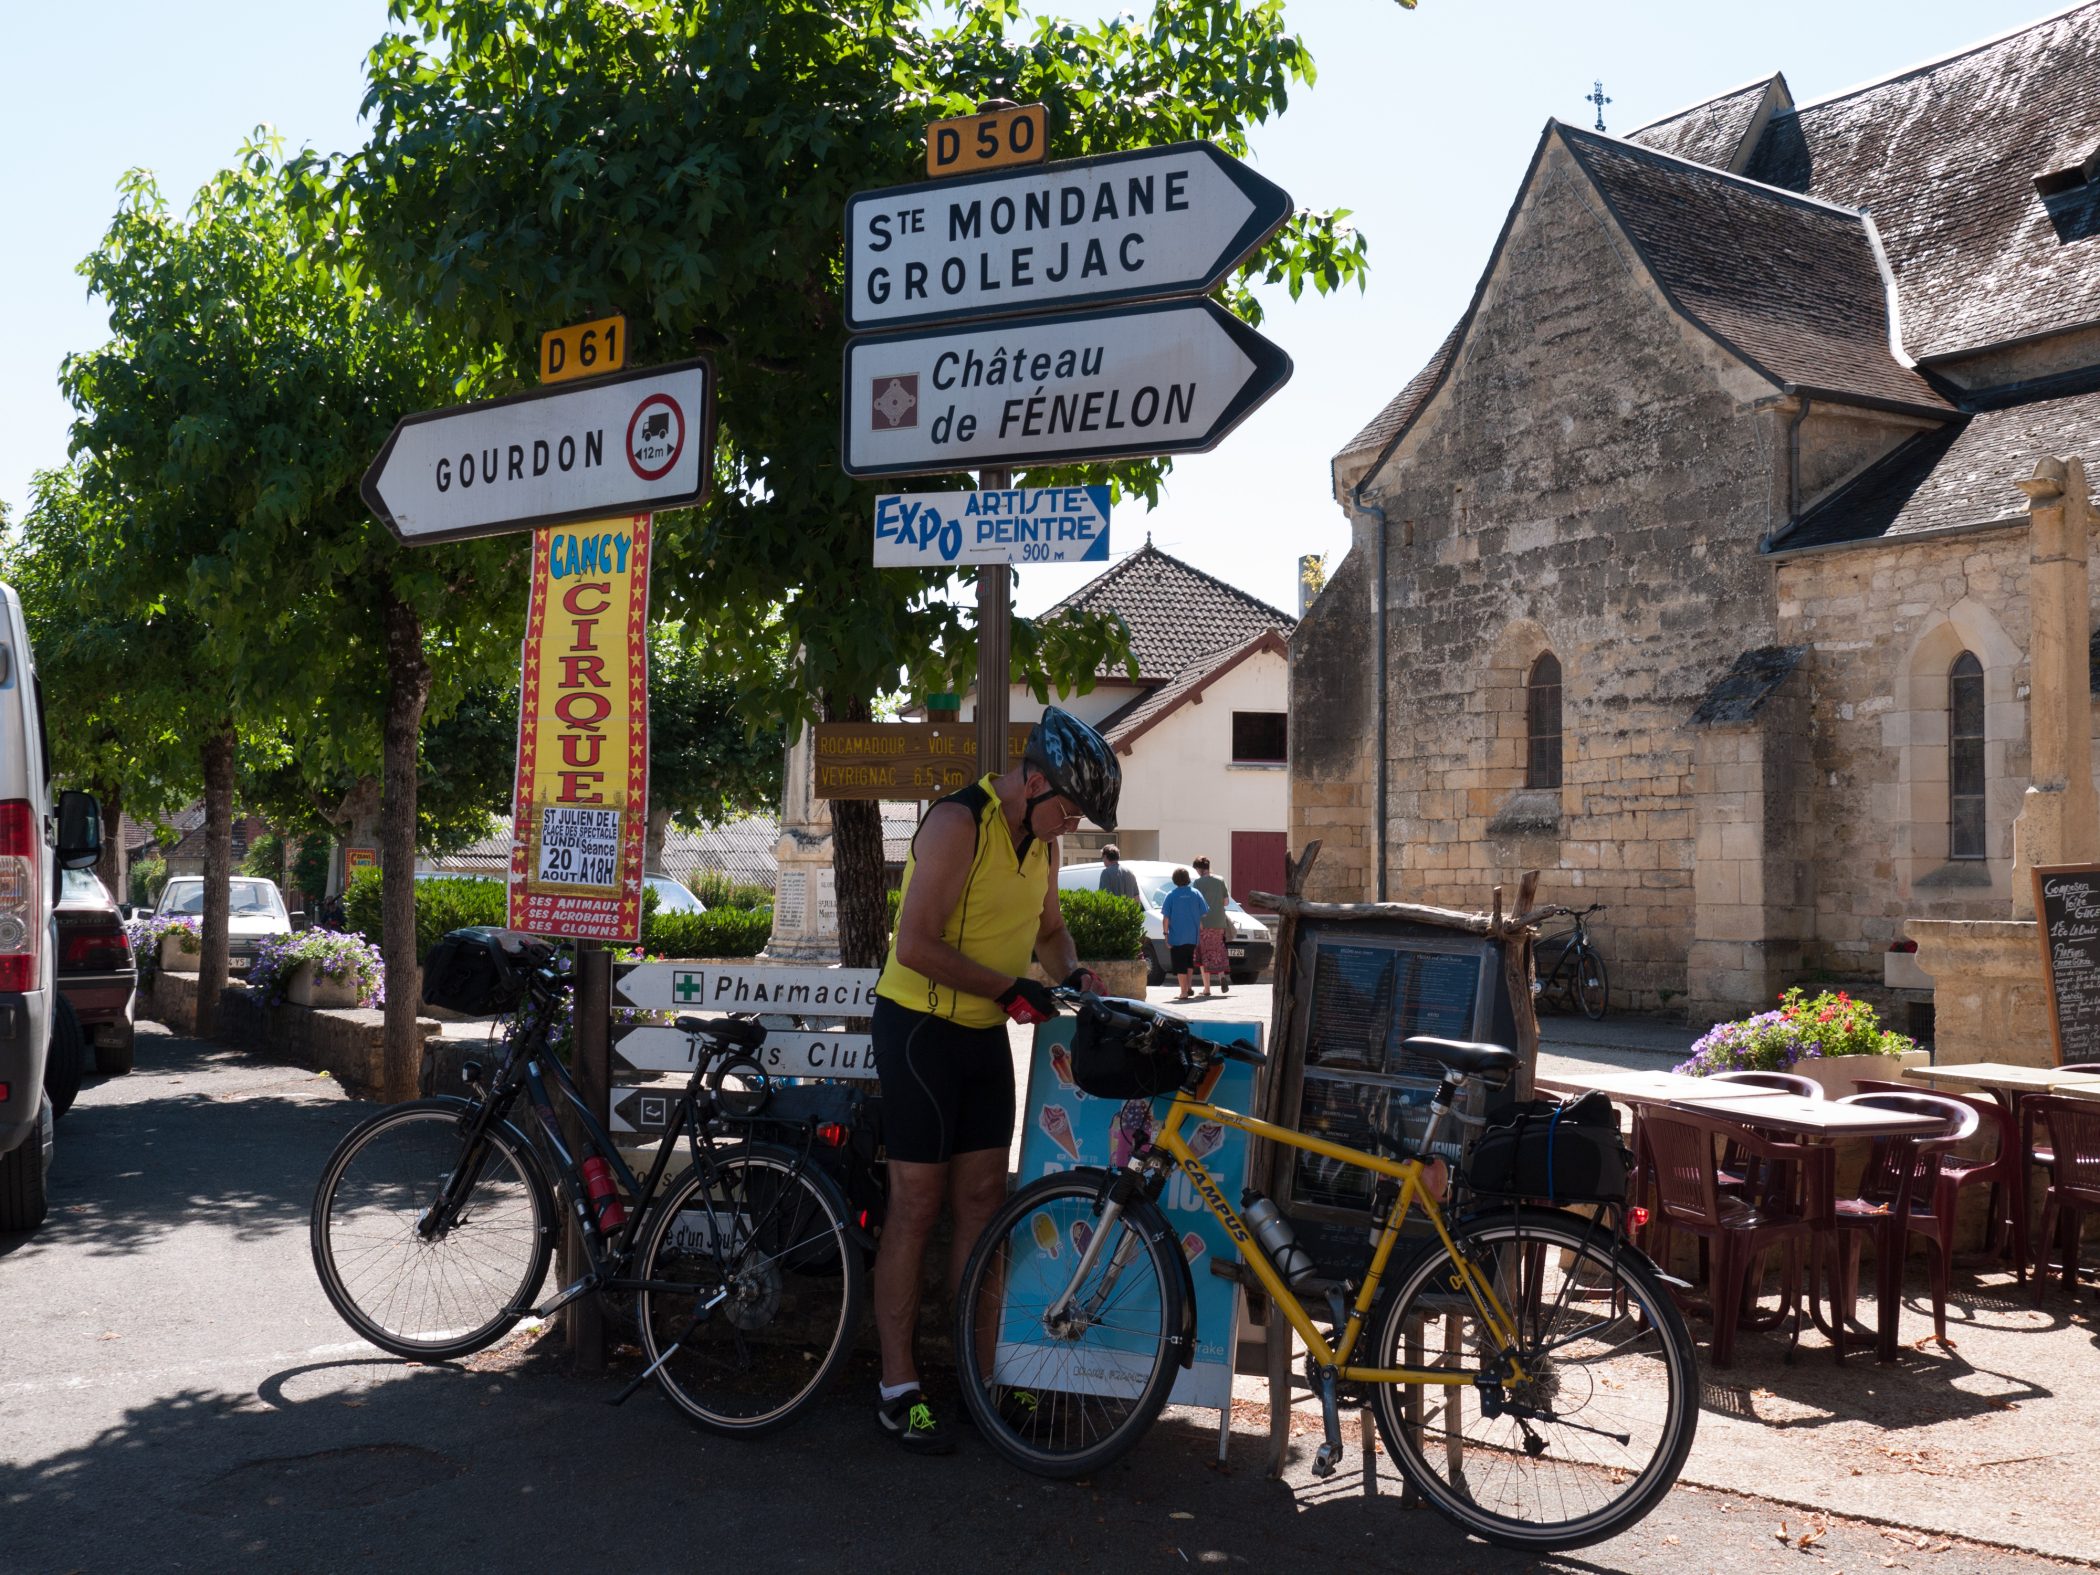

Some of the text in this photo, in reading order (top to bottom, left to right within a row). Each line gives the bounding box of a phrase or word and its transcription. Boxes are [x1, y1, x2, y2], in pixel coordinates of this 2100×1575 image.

[937, 115, 1034, 166] D 50
[949, 171, 1190, 242] MONDANE
[867, 233, 1145, 305] GROLEJAC
[548, 325, 616, 374] D 61
[932, 347, 1104, 391] Château
[931, 383, 1196, 445] de FÉNELON
[436, 429, 603, 493] GOURDON
[643, 446, 664, 461] 12m
[876, 496, 963, 560] EXPO
[977, 515, 1096, 543] PEINTRE
[550, 531, 632, 580] CANCY
[1022, 543, 1050, 561] 900
[554, 582, 612, 804] CIRQUE
[820, 737, 906, 755] ROCAMADOUR
[928, 737, 955, 754] VOIE
[821, 767, 897, 786] VEYRIGNAC
[943, 767, 963, 786] km
[544, 809, 556, 825] ST
[559, 809, 593, 827] JULIEN
[596, 812, 609, 828] DE
[543, 825, 617, 839] PLACE DES SPECTACLE
[543, 836, 579, 848] LUNDI
[548, 848, 572, 870] 20
[581, 840, 615, 857] Séance
[541, 870, 578, 882] AOUT
[528, 896, 620, 912] SES ANIMAUX
[528, 909, 619, 925] SES ACROBATES
[528, 921, 618, 936] SES CLOWNS
[808, 1040, 877, 1069] Club
[1184, 1159, 1249, 1243] CAMPUS
[1198, 1340, 1224, 1355] rake
